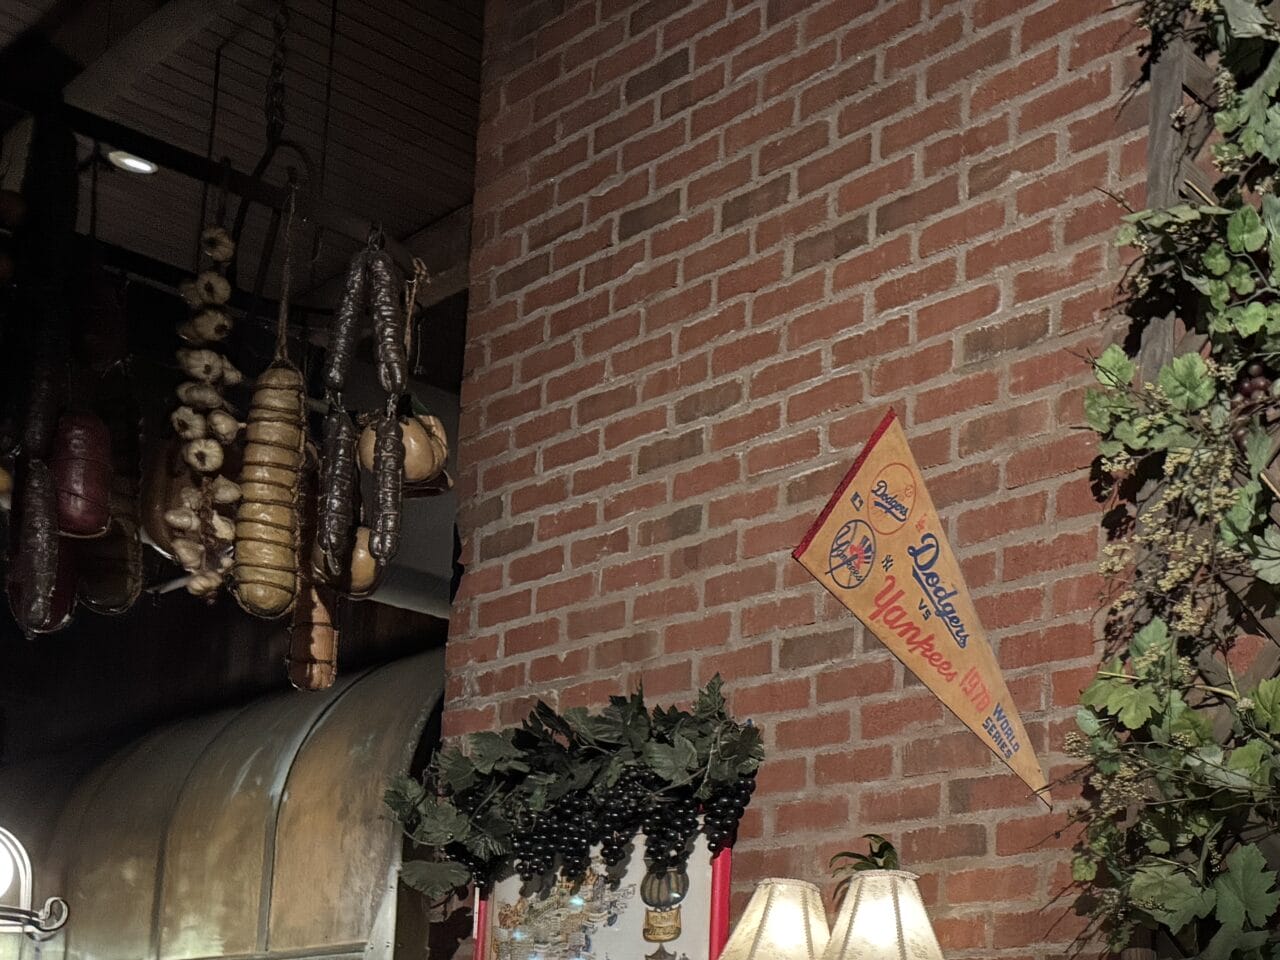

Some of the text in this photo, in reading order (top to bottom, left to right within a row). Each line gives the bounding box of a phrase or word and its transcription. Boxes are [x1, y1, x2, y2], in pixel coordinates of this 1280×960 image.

[871, 480, 909, 522] Dodgers
[827, 526, 863, 581] Yankees
[907, 532, 970, 648] Dodgers
[868, 575, 957, 682] Yankees
[982, 716, 1013, 759] SERIES
[993, 702, 1020, 753] WORLD
